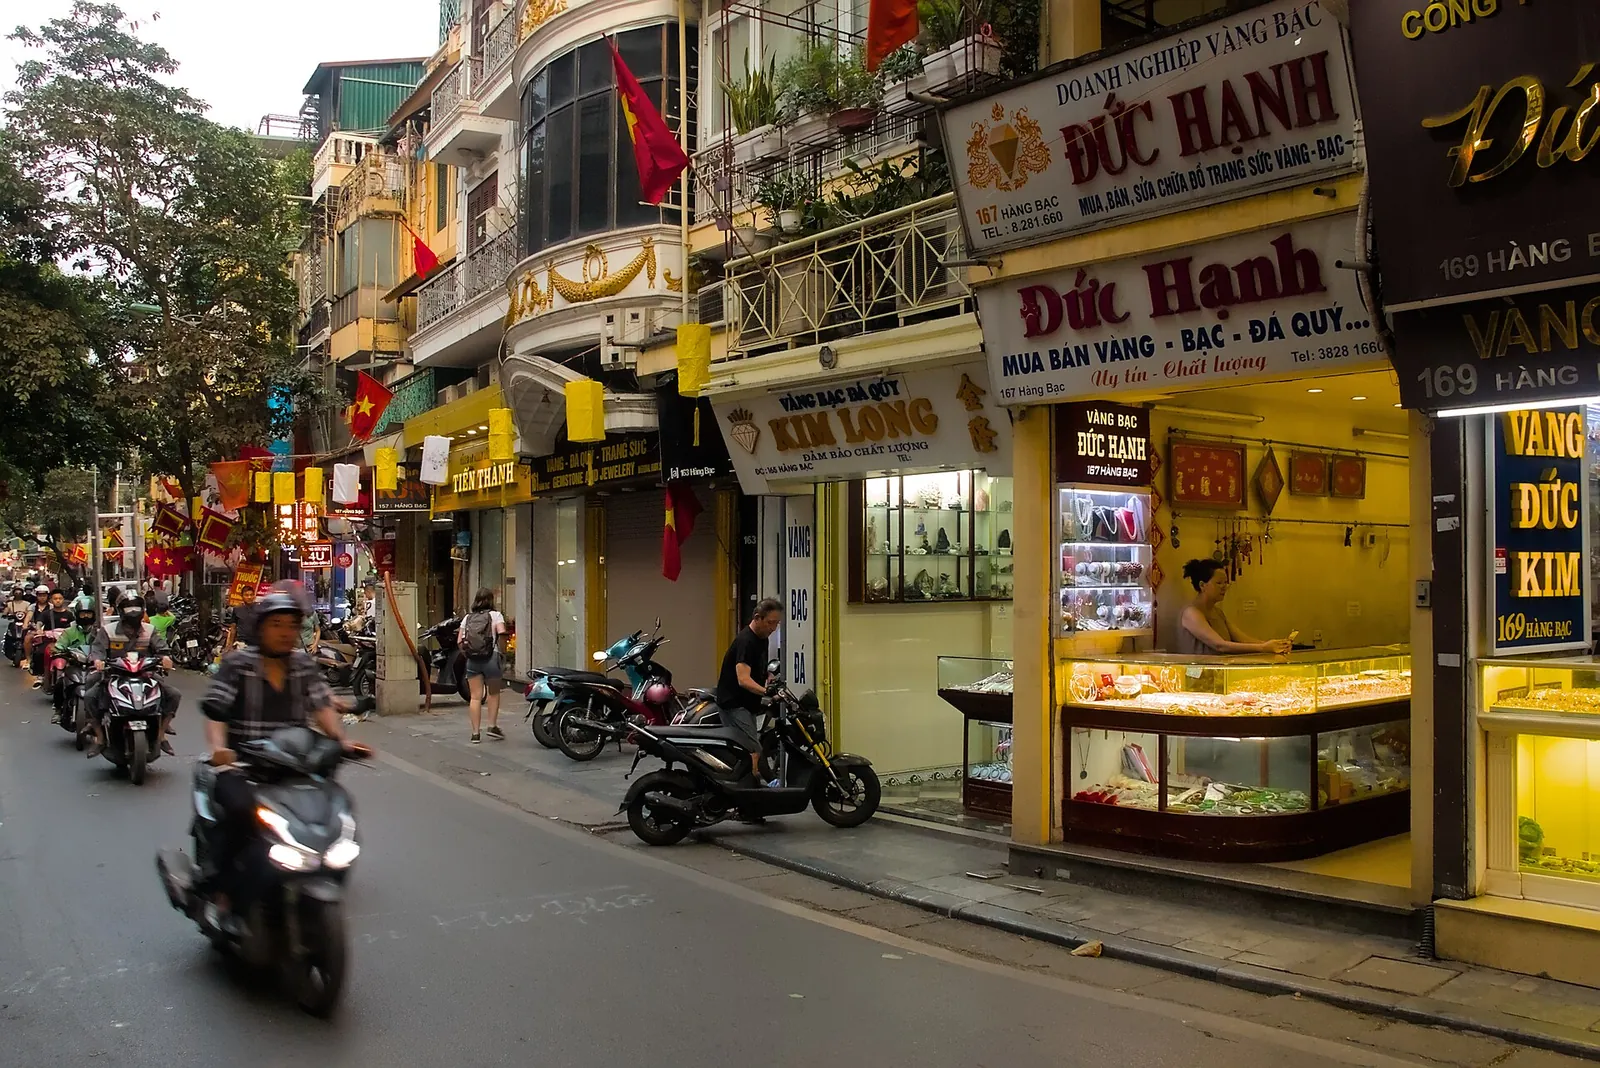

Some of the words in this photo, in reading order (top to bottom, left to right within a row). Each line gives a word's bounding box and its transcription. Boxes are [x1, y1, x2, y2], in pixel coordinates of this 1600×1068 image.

[1056, 65, 1122, 106] DOANH
[1125, 38, 1201, 85] NGHIỆP
[1205, 17, 1268, 58] VÀNG
[1272, 1, 1322, 38] BẠC
[1059, 92, 1160, 186] ĐỨC
[1167, 50, 1340, 157] HẠNH
[1133, 176, 1157, 203] SỬA
[1158, 171, 1188, 198] CHỮA
[1188, 162, 1206, 190] ĐỒ
[1206, 158, 1247, 186] TRANG
[1247, 148, 1274, 176] SỨC
[1274, 143, 1311, 170] VÀNG
[976, 205, 998, 226] 167
[1001, 203, 1033, 220] HÀNG
[1034, 195, 1060, 212] BẠC
[1011, 211, 1063, 233] 8.281.660
[1439, 254, 1479, 281] 169
[1487, 239, 1572, 274] HÀNG
[1017, 268, 1132, 338] Đức
[1142, 232, 1327, 320] Hạnh
[1002, 352, 1045, 377] MUA
[1049, 342, 1090, 370] BÁN
[1093, 334, 1155, 363] VÀNG
[1181, 324, 1225, 356] BẠC
[1249, 311, 1285, 343] ĐÁ
[1318, 345, 1349, 361] 3828
[1124, 366, 1148, 384] tín
[1163, 355, 1207, 380] Chất
[1213, 355, 1268, 376] lượng
[1417, 363, 1478, 398] 169
[1495, 365, 1579, 391] HÀNG
[779, 393, 817, 412] VÀNG
[816, 388, 846, 409] BẠC
[846, 381, 869, 402] ĐÁ
[1000, 387, 1015, 398] 167
[1019, 384, 1044, 397] Hàng
[1046, 382, 1066, 396] Bạc
[768, 411, 836, 451] KIM
[837, 399, 938, 443] LONG
[1086, 409, 1114, 426] VÀNG
[1117, 414, 1138, 430] BẠC
[601, 441, 629, 463] TRANG
[802, 448, 828, 461] ĐẢM
[831, 446, 852, 459] BẢO
[855, 443, 885, 457] CHẤT
[888, 441, 929, 454] LƯỢNG
[1077, 428, 1105, 457] ĐỨC
[1108, 435, 1147, 463] HẠNH
[477, 461, 515, 489] THÀNH
[680, 468, 690, 477] 163
[704, 466, 716, 477] Bạc
[1087, 465, 1100, 475] 167
[1100, 463, 1122, 476] HÀNG
[1122, 467, 1138, 480] BẠC
[1518, 467, 1578, 530] ĐỨC
[743, 535, 756, 545] 163
[788, 519, 811, 558] VÀNG
[1518, 552, 1580, 597] KIM
[791, 589, 808, 627] BẠC
[1497, 612, 1525, 641] 169
[1525, 618, 1554, 639] HÀNG
[1554, 620, 1572, 640] BẠC
[794, 644, 806, 685] ĐÁ
